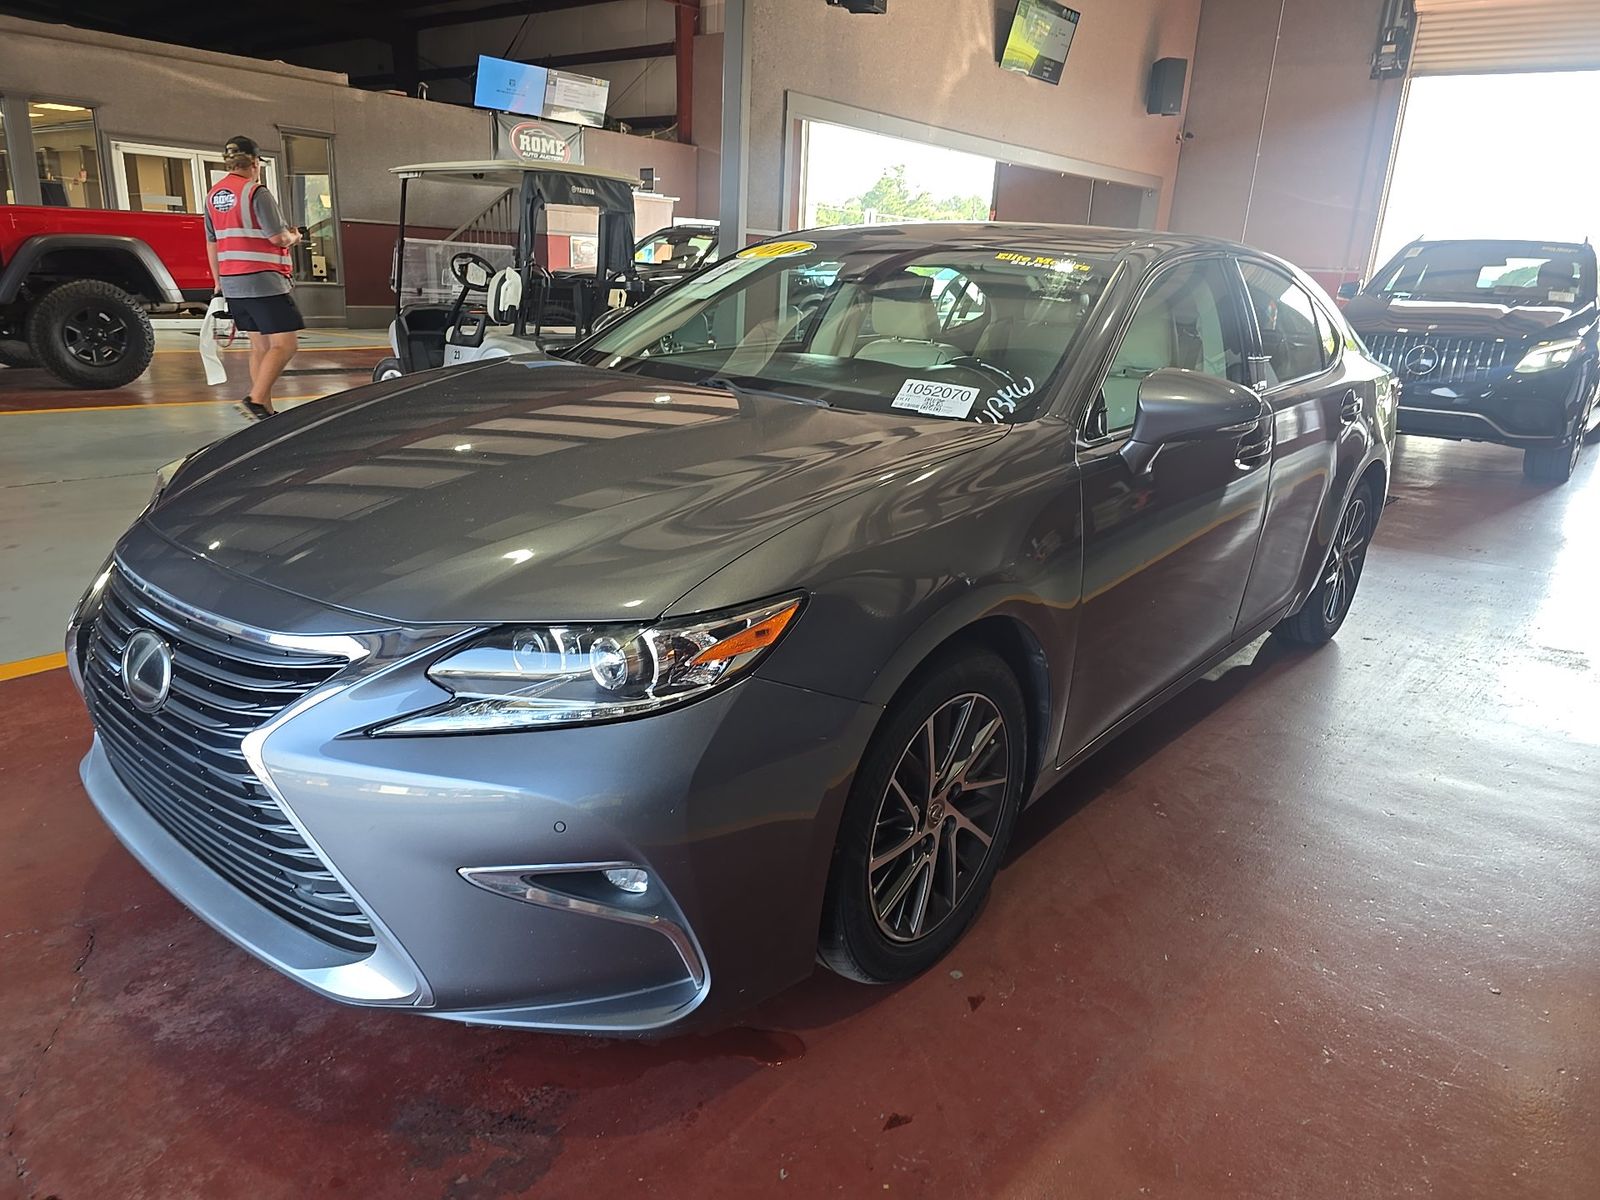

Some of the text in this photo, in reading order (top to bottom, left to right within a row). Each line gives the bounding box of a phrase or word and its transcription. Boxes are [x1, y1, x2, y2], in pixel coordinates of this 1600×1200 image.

[519, 134, 566, 156] ROME
[522, 151, 538, 159] AUTO
[994, 252, 1032, 262] Elite
[454, 350, 461, 360] 23
[906, 382, 972, 402] 1052070
